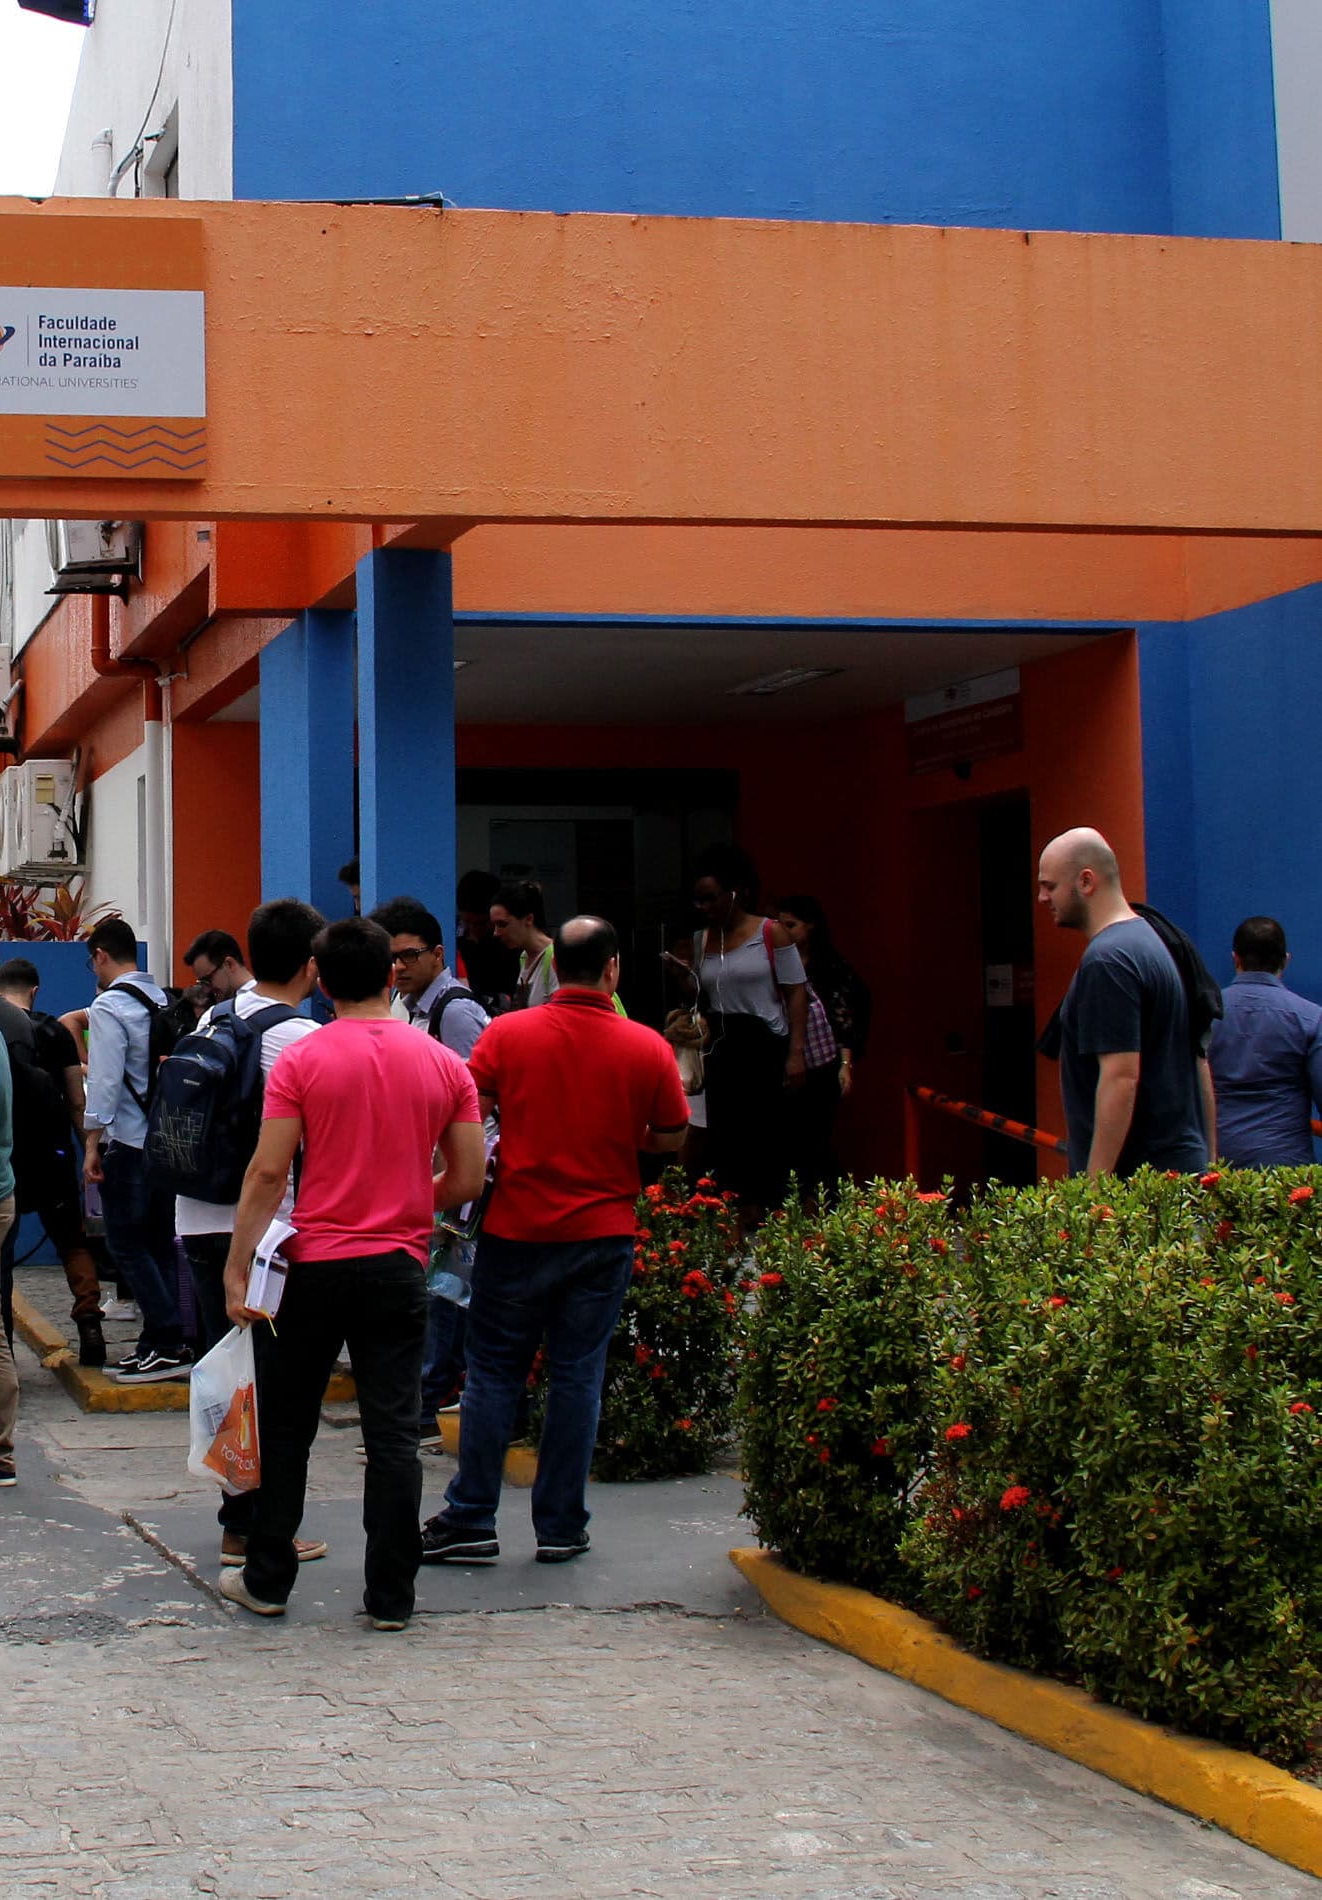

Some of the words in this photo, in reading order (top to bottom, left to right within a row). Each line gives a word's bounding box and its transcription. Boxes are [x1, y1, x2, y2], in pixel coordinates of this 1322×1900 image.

[38, 315, 117, 331] Faculdade
[38, 334, 140, 351] Internacional
[38, 352, 57, 368] da
[62, 352, 122, 369] Paraíba
[58, 377, 137, 390] UNIVERSITIES
